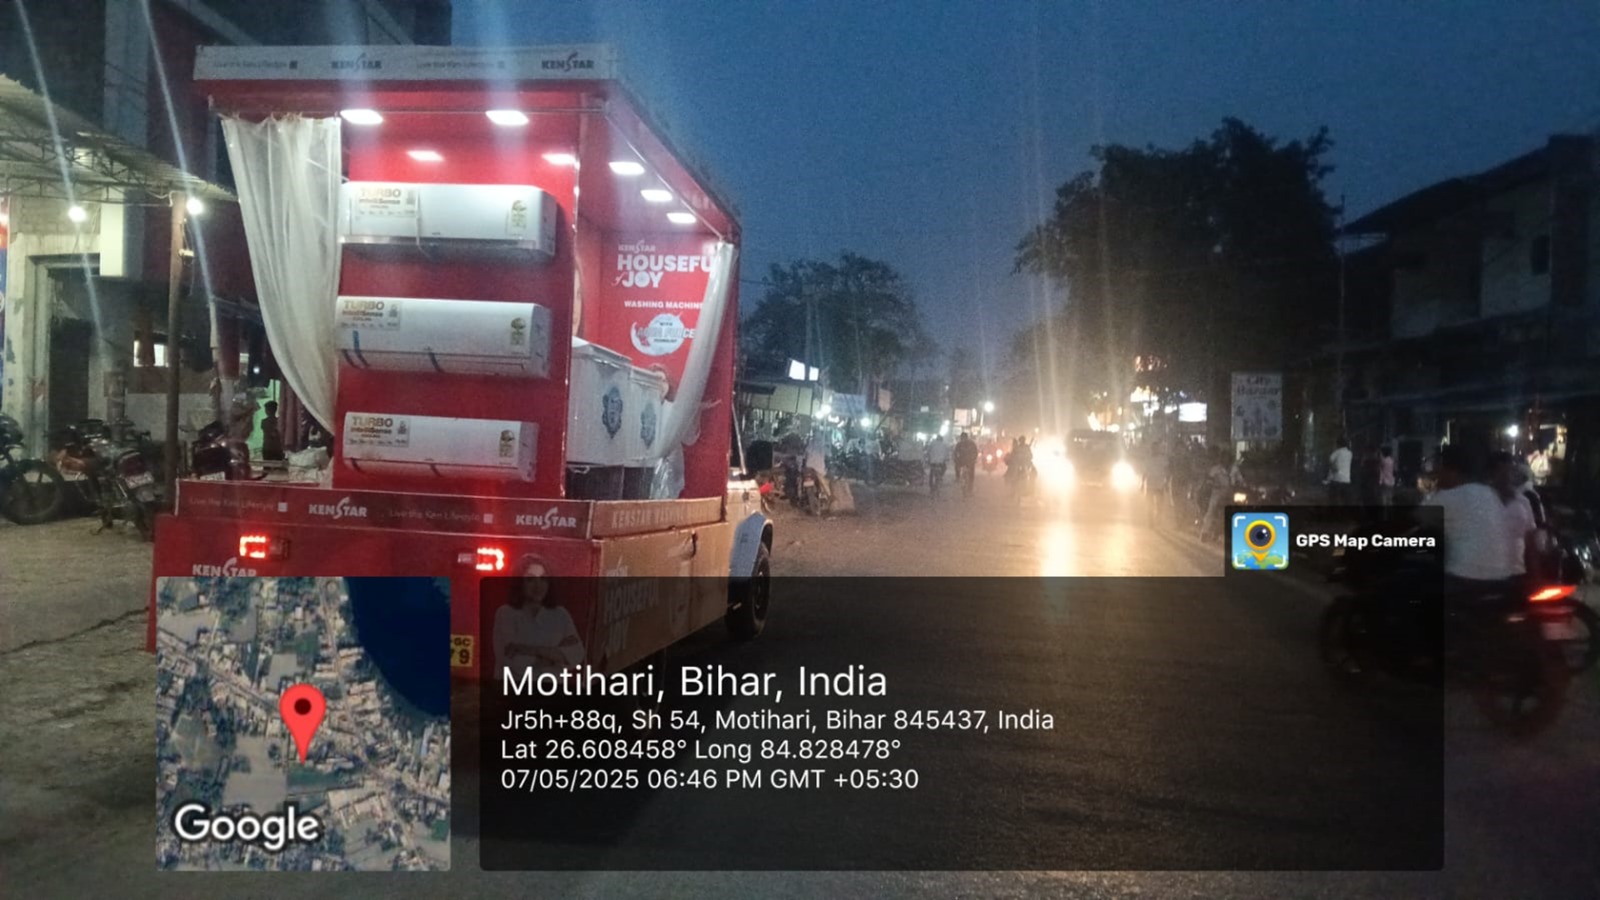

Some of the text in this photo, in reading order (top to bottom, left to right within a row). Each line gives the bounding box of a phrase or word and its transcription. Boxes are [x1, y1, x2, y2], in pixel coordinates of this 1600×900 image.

[542, 52, 594, 72] KENSTAR
[618, 239, 656, 254] KENSTAR
[622, 270, 664, 288] JOY
[344, 300, 385, 311] TURBO
[624, 300, 664, 309] WASHING
[352, 415, 394, 428] TURBO
[308, 496, 368, 520] KENSTAR
[515, 506, 577, 530] KENSTAR
